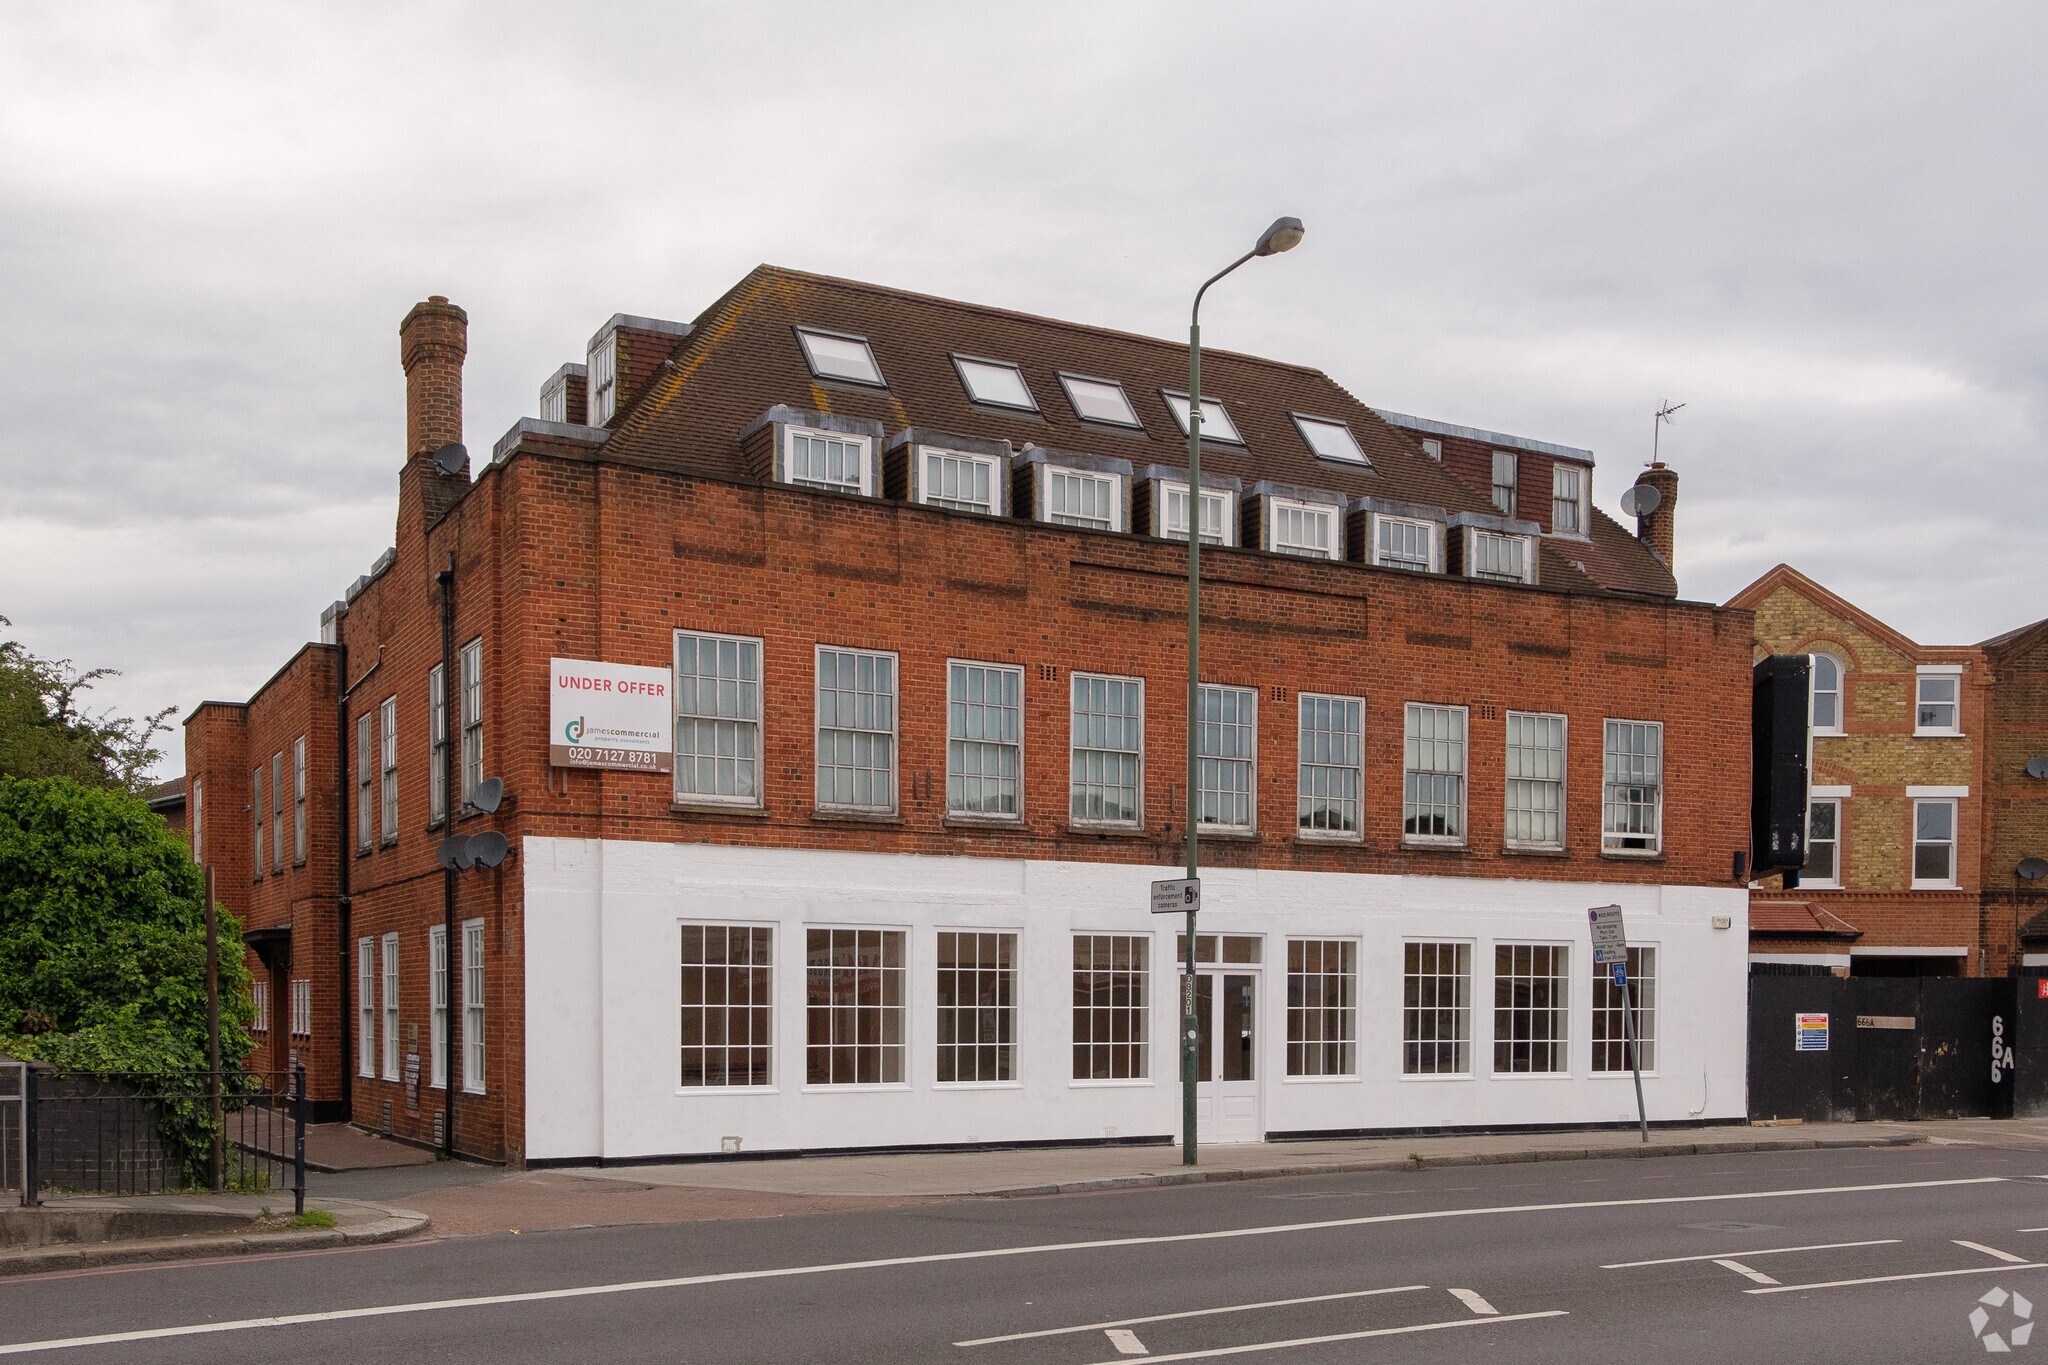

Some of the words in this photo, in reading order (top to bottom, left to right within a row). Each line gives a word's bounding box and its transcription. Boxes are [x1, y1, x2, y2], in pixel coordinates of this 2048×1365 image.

[559, 675, 612, 692] UNDER
[617, 680, 665, 697] OFFER
[586, 727, 660, 739] jamescommercial
[568, 747, 592, 760] 020
[595, 749, 625, 762] 7127
[628, 752, 657, 764] 8781
[569, 758, 657, 770] info@jamescommercial.co.uk
[1160, 884, 1176, 892] Traffic
[1857, 1017, 1875, 1028] 666A
